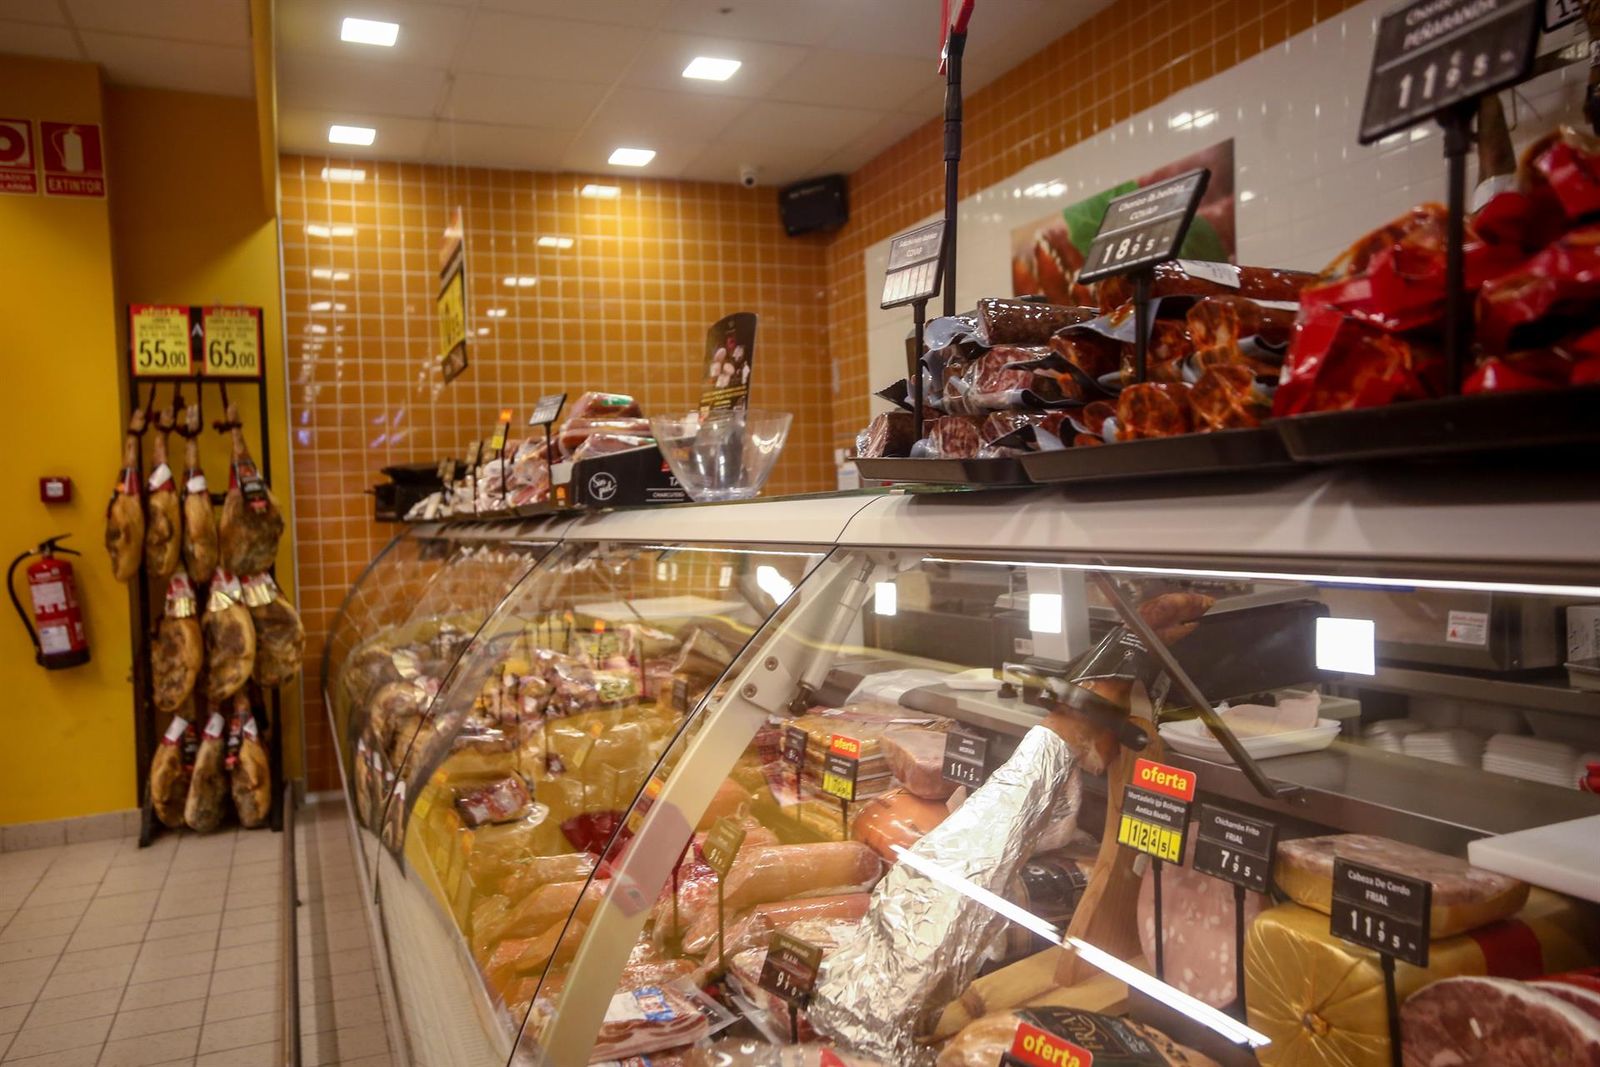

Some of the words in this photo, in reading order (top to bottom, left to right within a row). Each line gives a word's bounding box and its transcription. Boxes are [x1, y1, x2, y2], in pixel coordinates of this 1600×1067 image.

[49, 176, 102, 193] EXTINTOR
[834, 738, 857, 753] oferta
[1141, 766, 1187, 791] oferta
[1224, 831, 1244, 845] FRIAL
[1347, 869, 1374, 886] Cabeza
[1375, 877, 1386, 889] De
[1387, 881, 1411, 897] Cerdo
[1365, 889, 1389, 906] FRIAL
[1023, 1035, 1081, 1067] oferta
